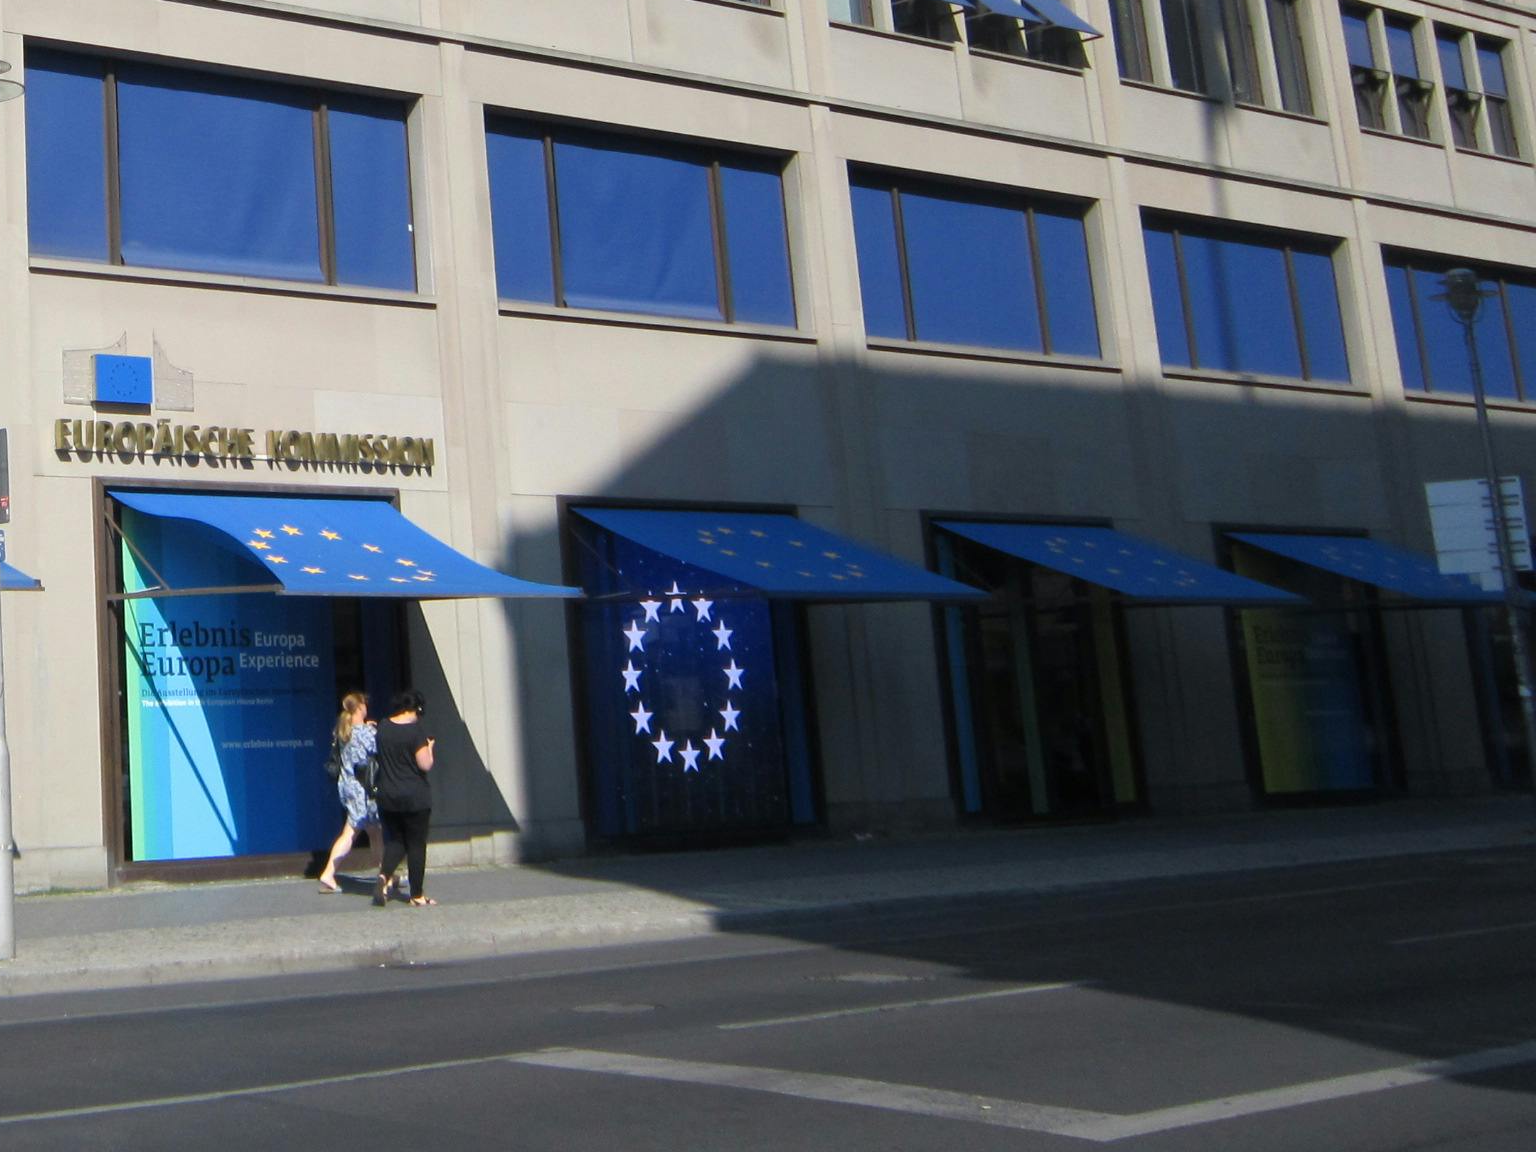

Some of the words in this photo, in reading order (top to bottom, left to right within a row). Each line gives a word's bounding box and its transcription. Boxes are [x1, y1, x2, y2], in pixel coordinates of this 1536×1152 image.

[54, 418, 255, 459] EUROPÄISCHE
[265, 429, 434, 467] KOMMISSION
[139, 619, 252, 648] Erlebnis
[254, 631, 306, 650] Europa
[141, 651, 235, 683] Europa
[239, 651, 320, 672] Experience
